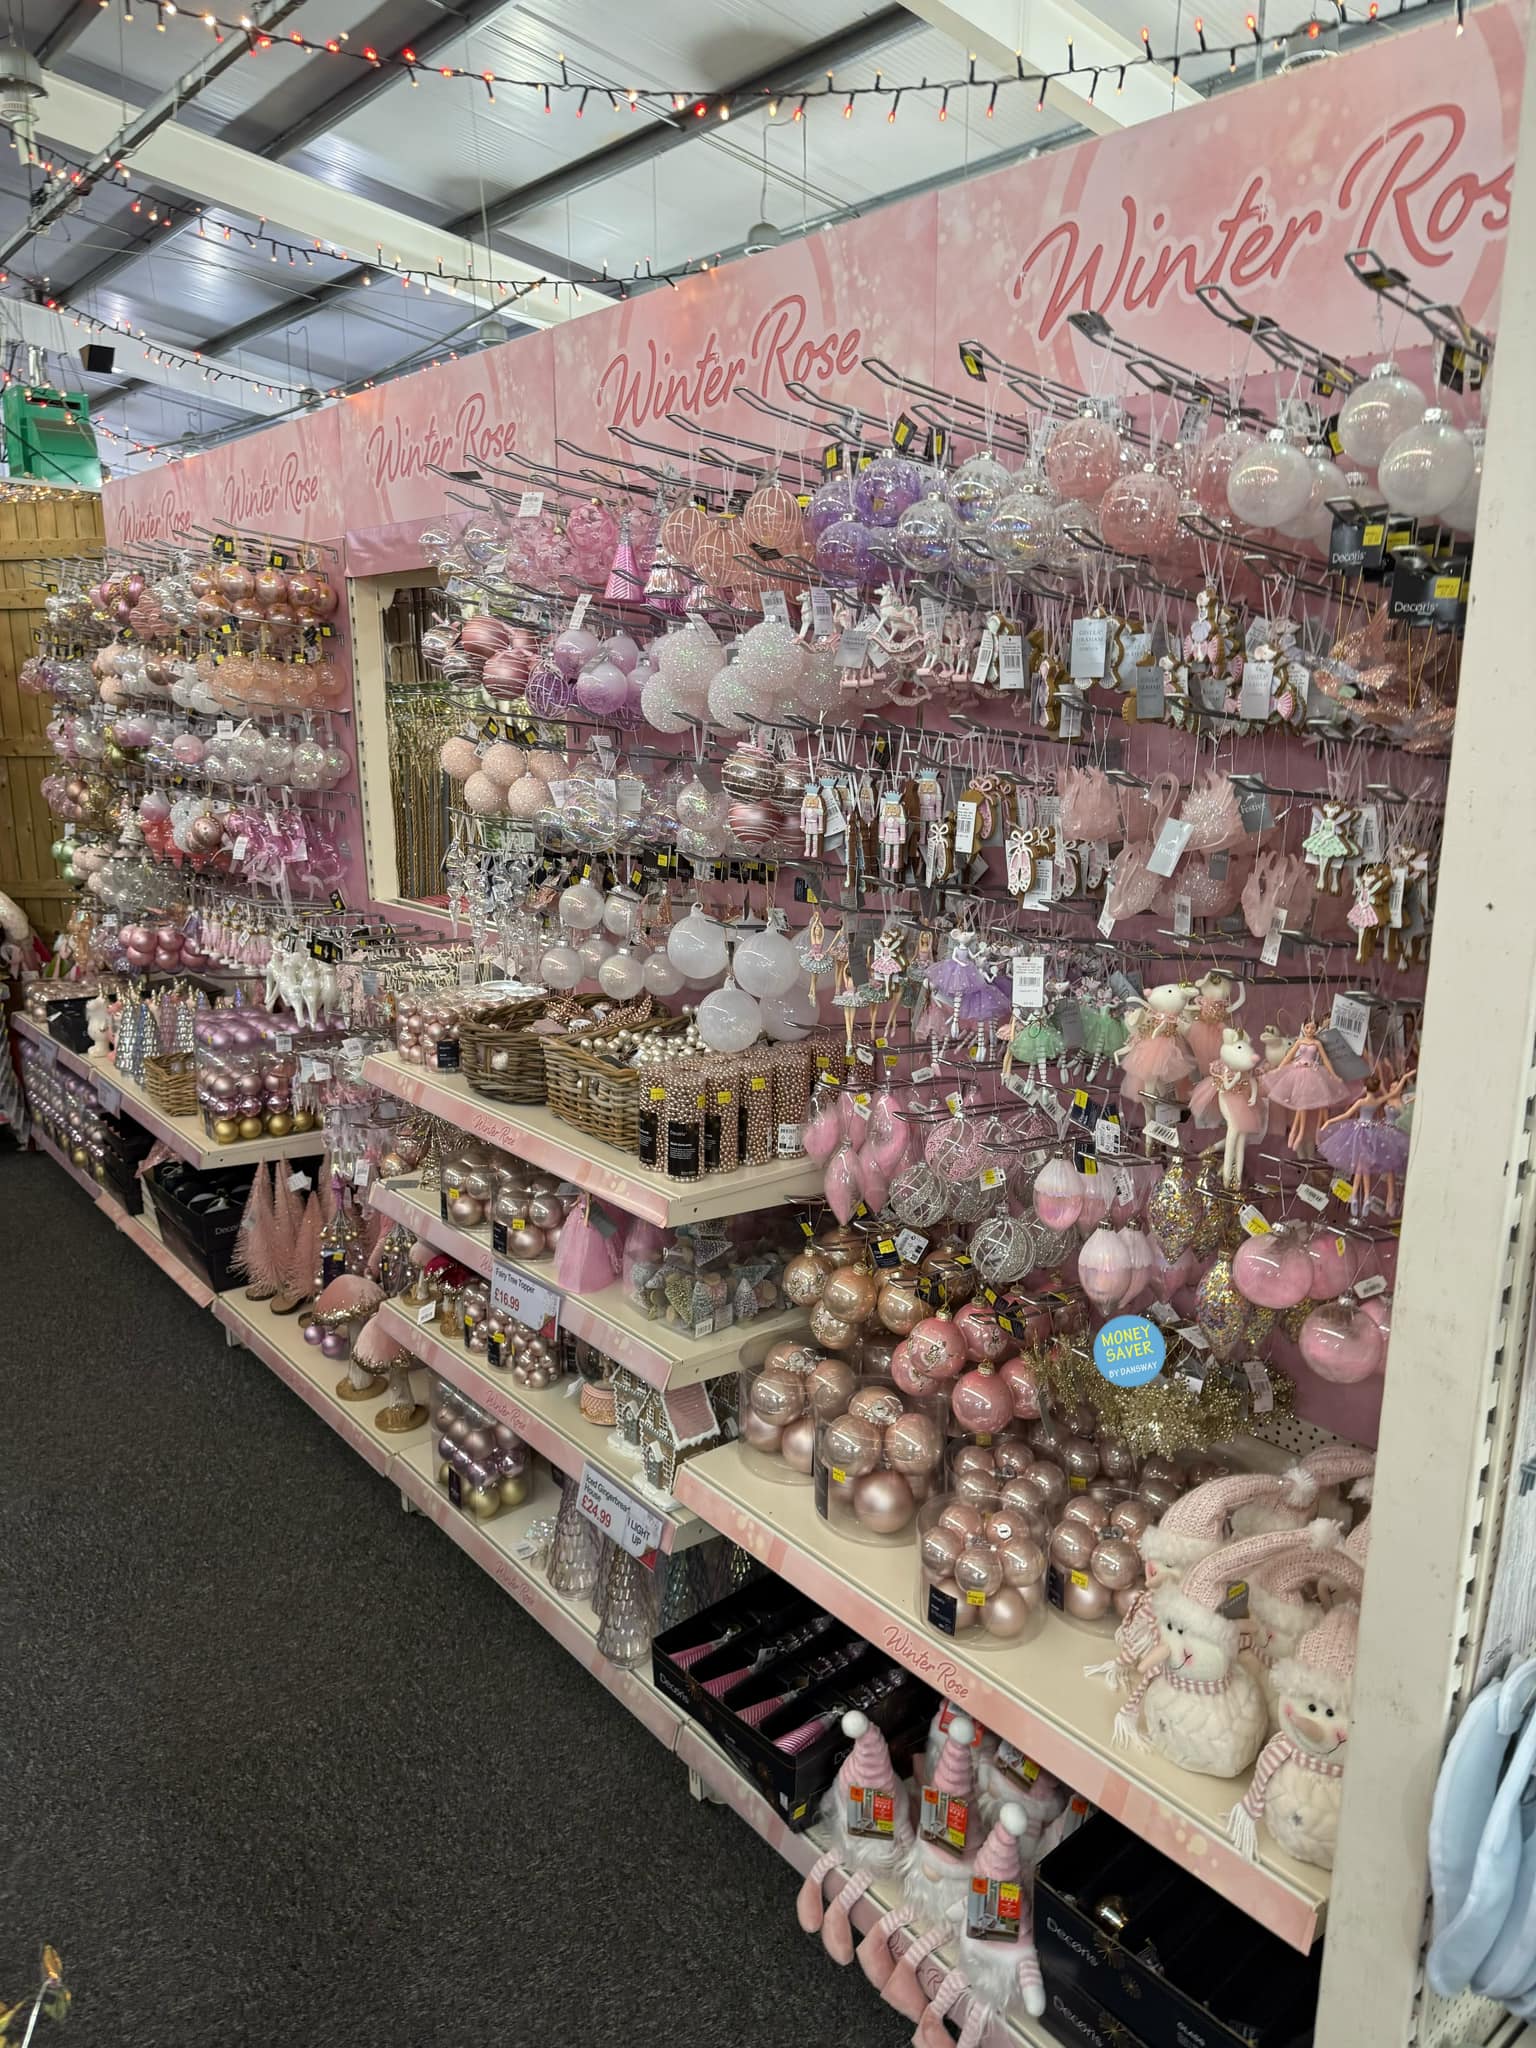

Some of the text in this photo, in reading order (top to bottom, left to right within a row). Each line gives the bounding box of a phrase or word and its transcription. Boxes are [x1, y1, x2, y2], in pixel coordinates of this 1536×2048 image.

[1013, 103, 1513, 341] Winter Ros
[596, 294, 861, 428] Winter Rose
[367, 392, 517, 489] Winter Rose
[223, 451, 319, 523] Winter Rose
[117, 489, 191, 545] Winter Rose
[1332, 551, 1366, 565] Decoris
[1394, 601, 1438, 614] Decoris
[495, 1267, 508, 1281] Fairy
[517, 1278, 535, 1294] Topper
[494, 1287, 520, 1311] £16.99
[584, 1482, 602, 1502] House
[585, 1473, 598, 1489] Iced
[581, 1494, 612, 1528] £24.99
[630, 1519, 651, 1541] LIGHT
[631, 1533, 642, 1547] UP
[883, 1626, 969, 1698] Winter Rose
